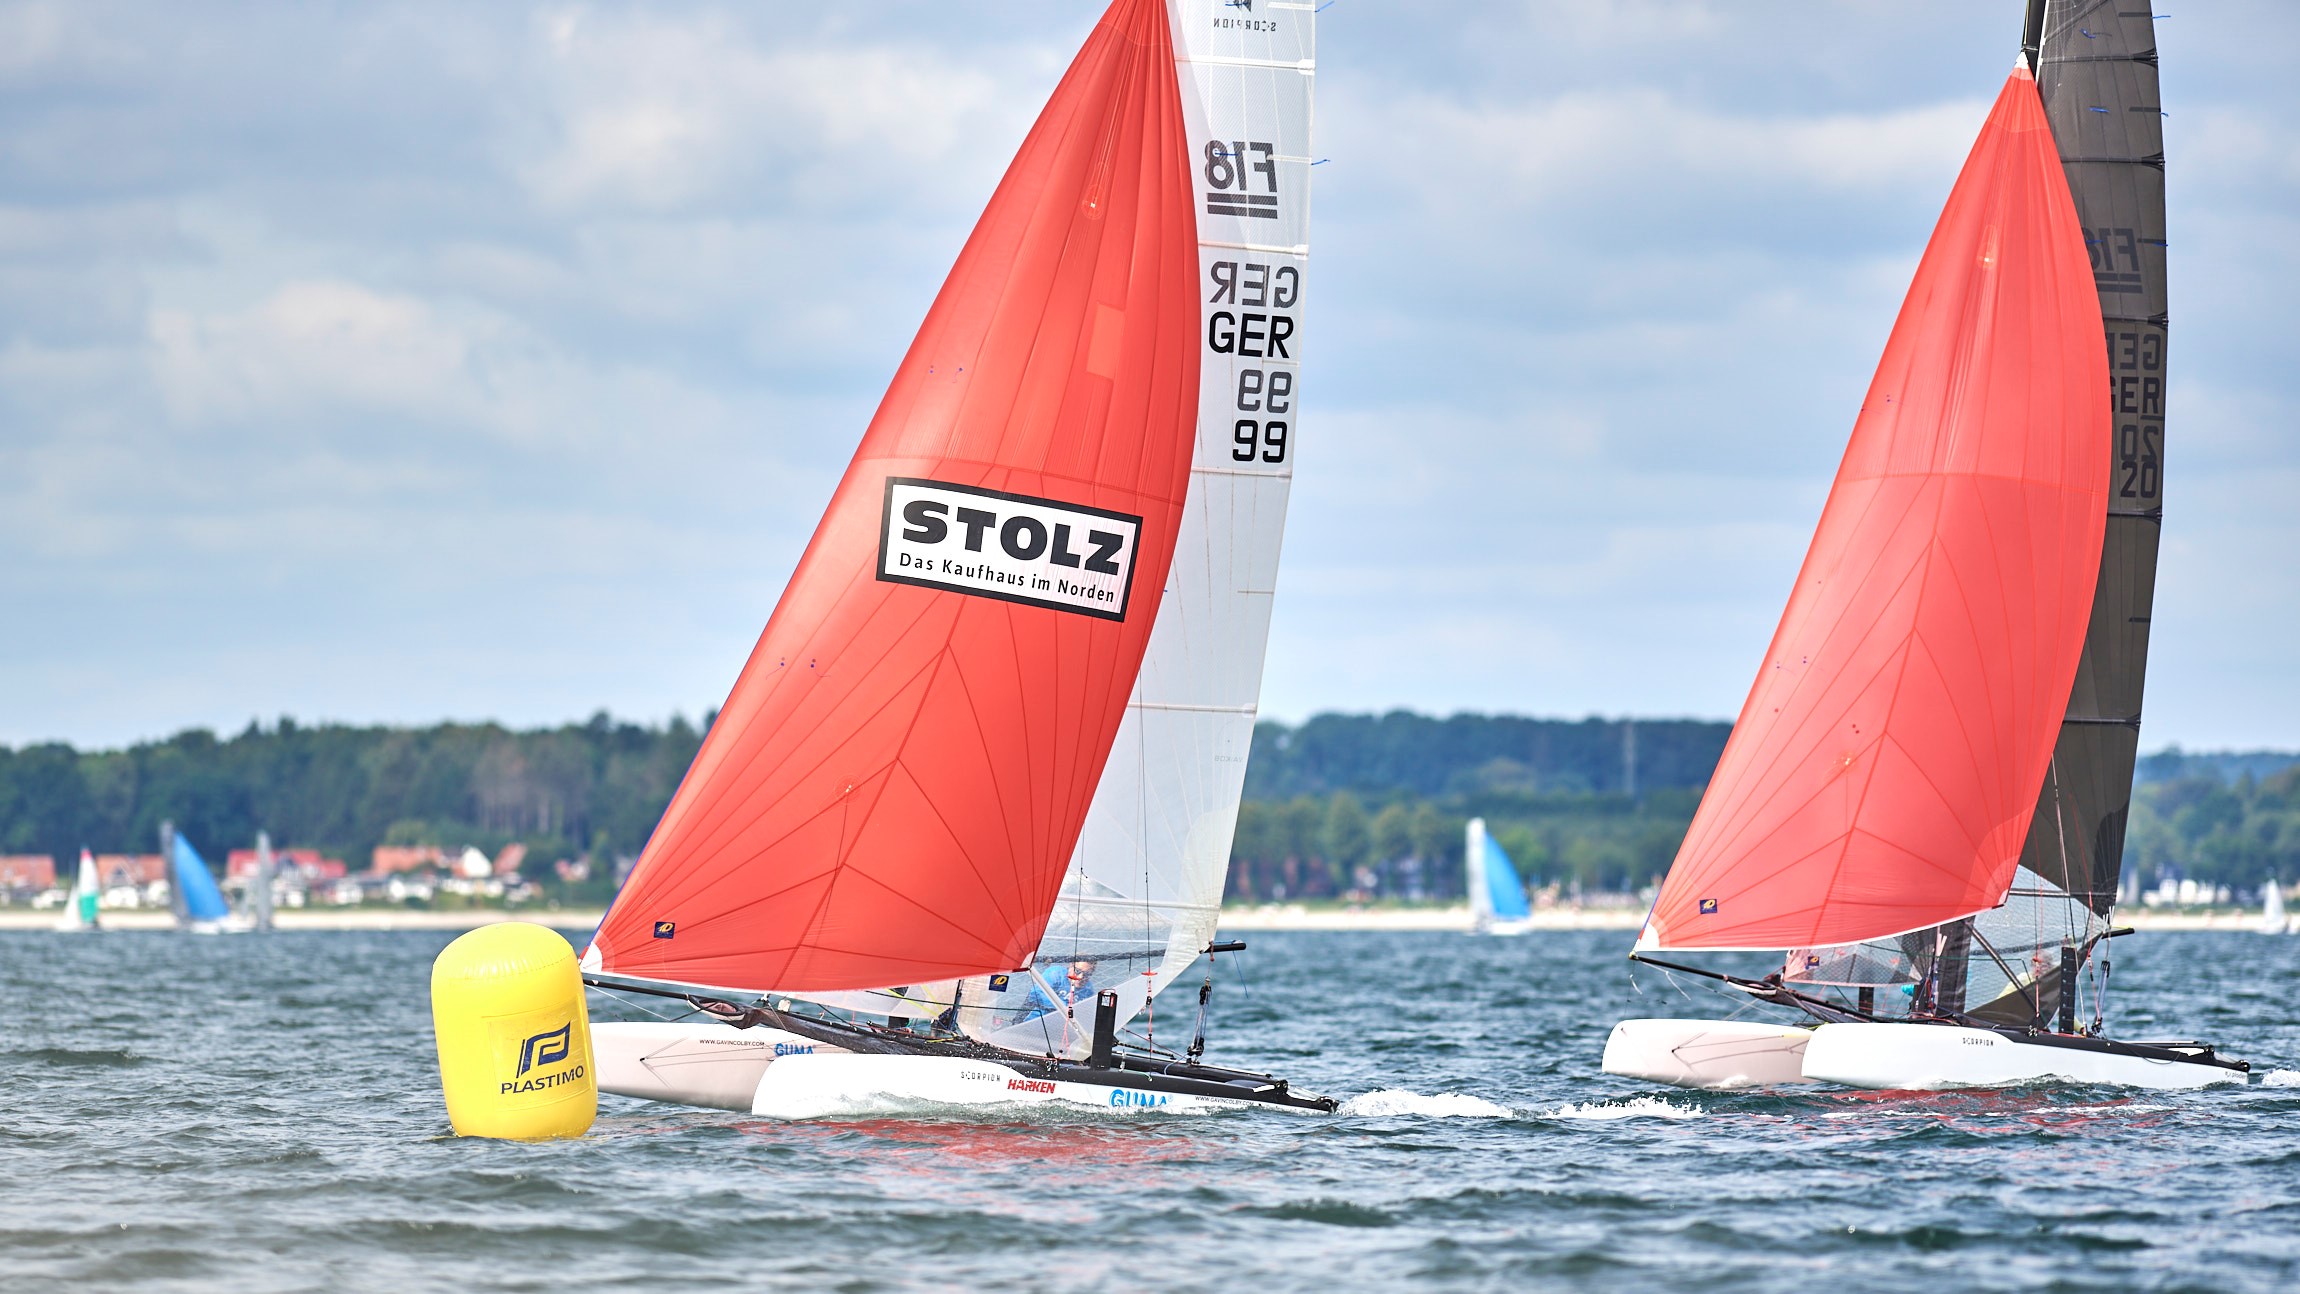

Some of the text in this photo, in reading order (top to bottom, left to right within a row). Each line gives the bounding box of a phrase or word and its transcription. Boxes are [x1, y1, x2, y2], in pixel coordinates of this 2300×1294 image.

[1208, 311, 1294, 359] GER
[1232, 419, 1288, 464] 99
[2120, 460, 2159, 499] 20
[902, 500, 1125, 576] STOLZ
[900, 552, 1115, 603] Das Kaufhaus im Norden
[699, 1039, 765, 1047] WWW.GAVINCOLBY.COM
[501, 1065, 584, 1095] PLASTIMO
[960, 1071, 1001, 1082] SCORPION
[1007, 1079, 1056, 1094] HARKEN
[1195, 1095, 1255, 1106] WWW.GAVINCOLBY.COM
